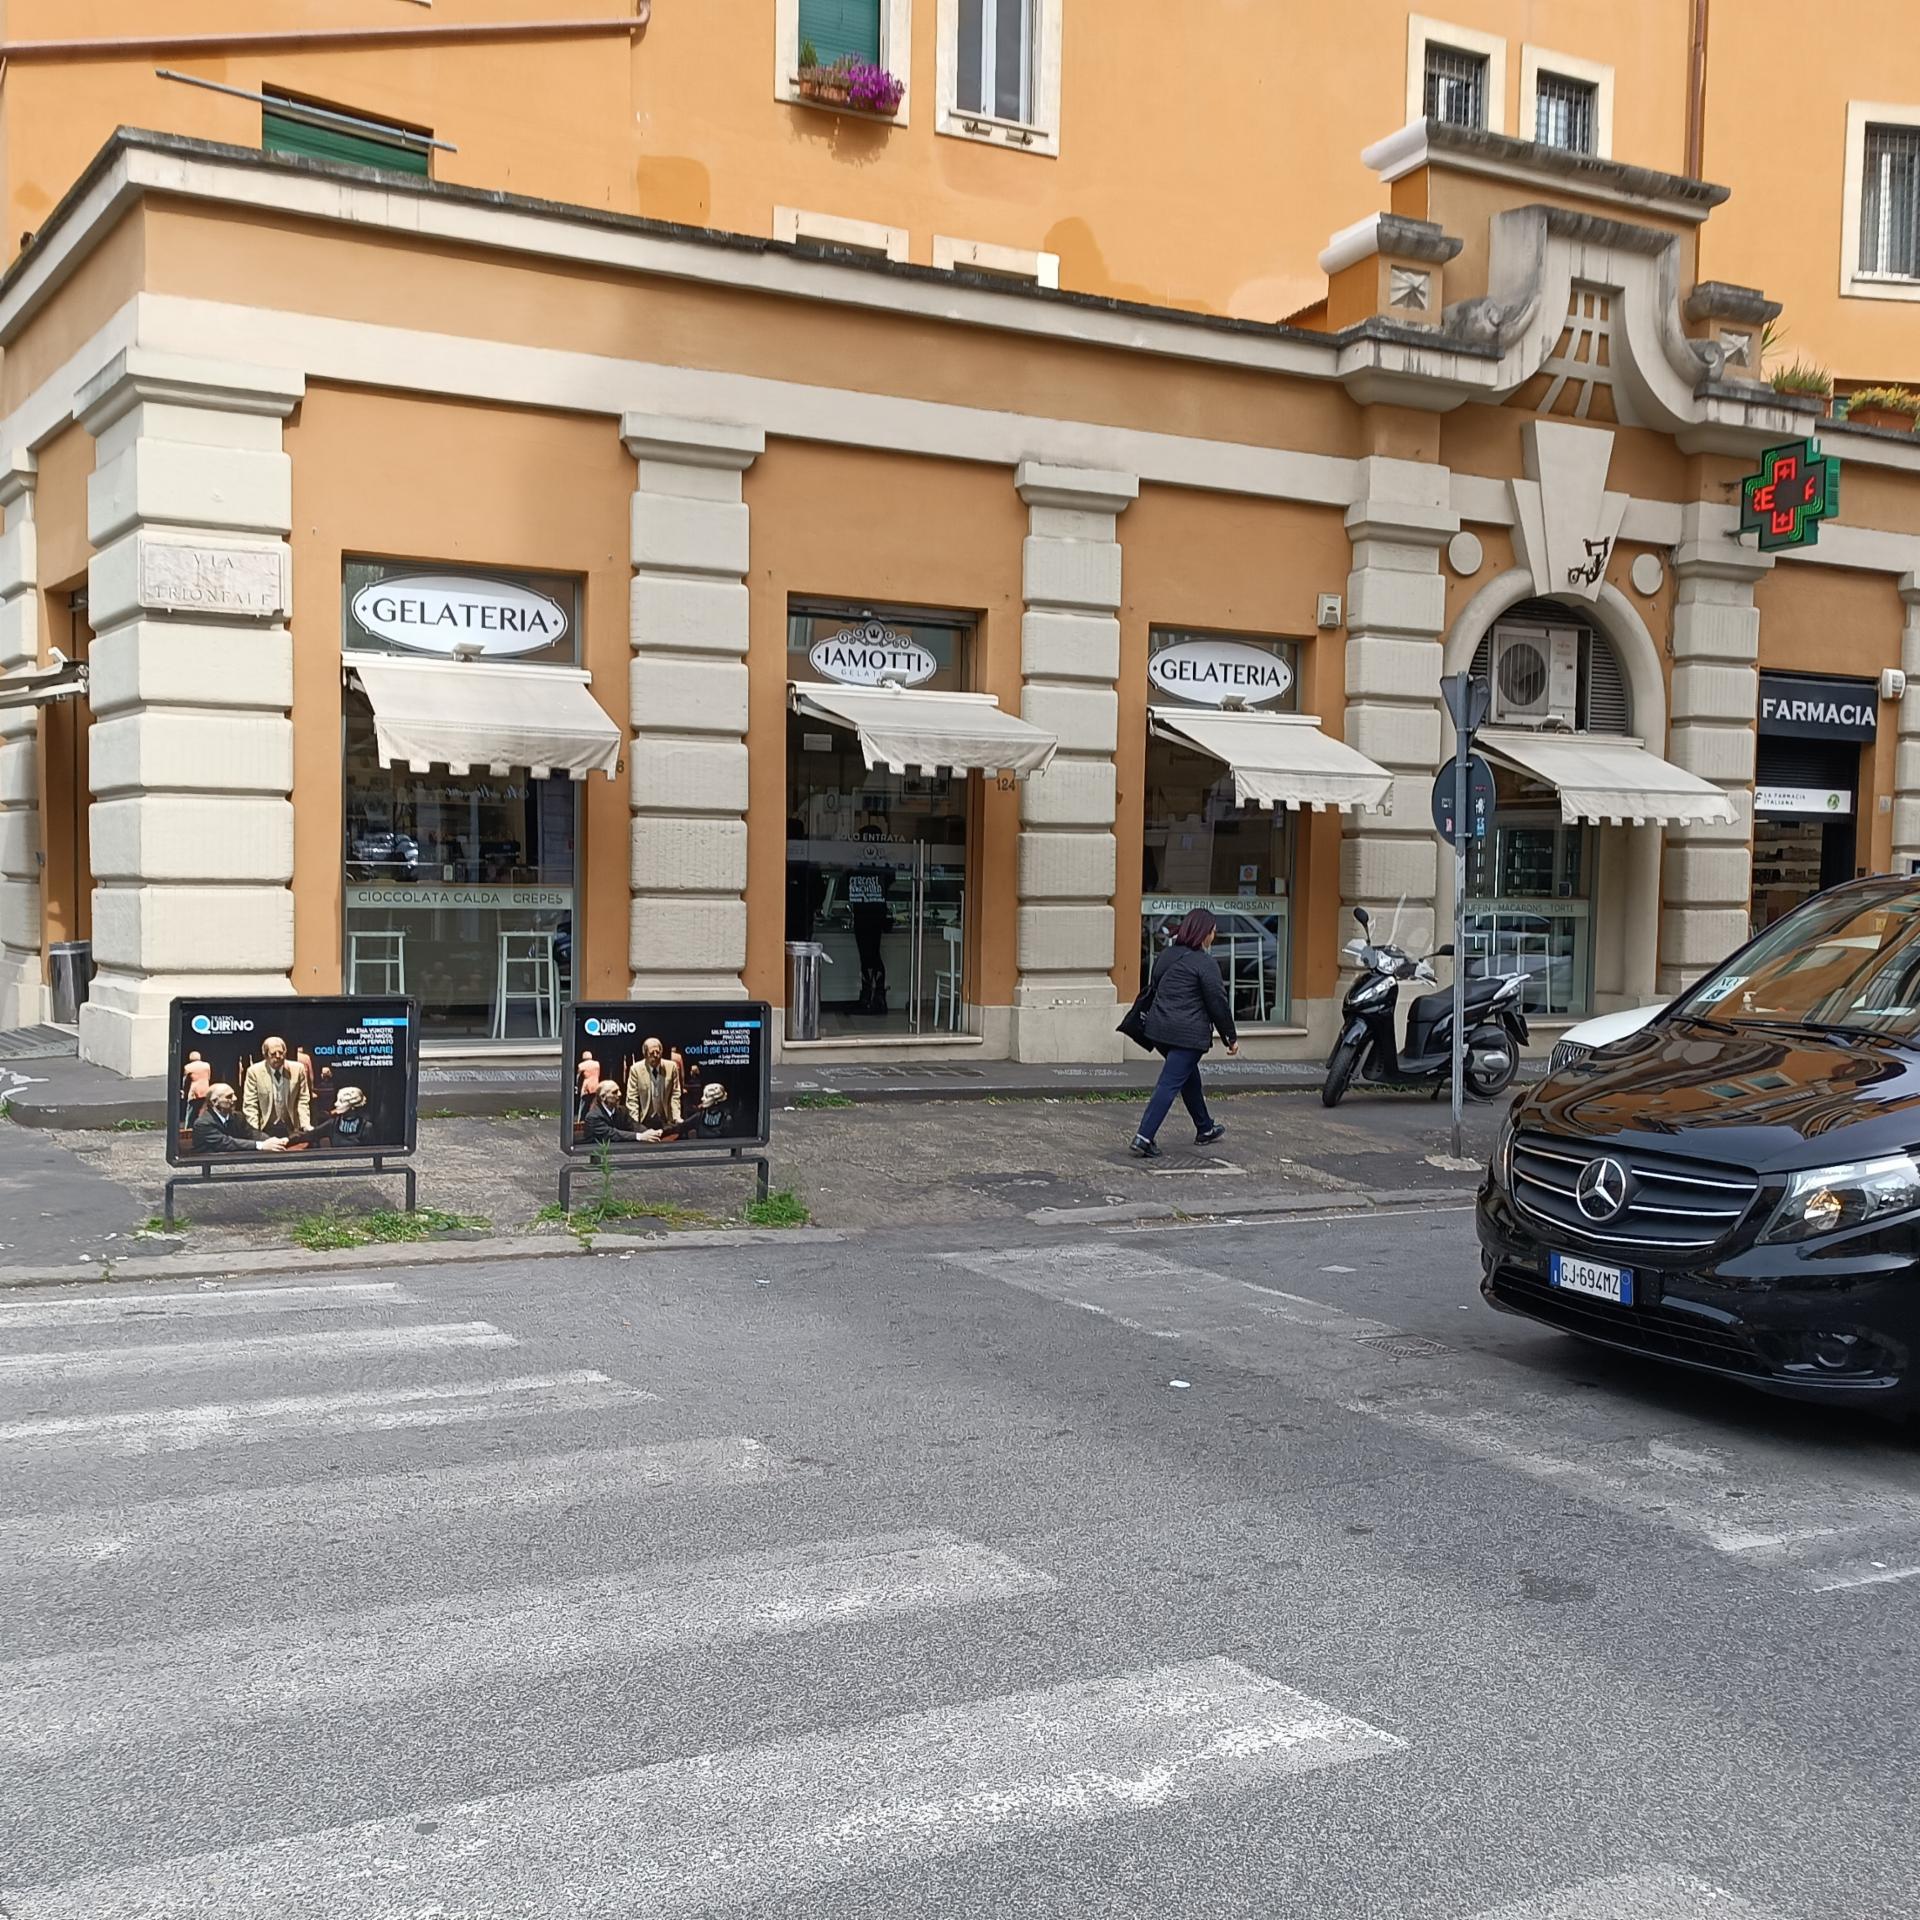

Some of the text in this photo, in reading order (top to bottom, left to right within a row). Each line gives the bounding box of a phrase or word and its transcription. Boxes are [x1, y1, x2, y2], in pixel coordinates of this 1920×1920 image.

[193, 553, 234, 568] VIA
[372, 597, 549, 633] GELATERIA
[824, 646, 921, 672] IAMOTTI
[1160, 658, 1281, 687] GELATERIA
[1762, 698, 1876, 726] FARMACIA
[997, 778, 1016, 791] 124
[1778, 793, 1806, 801] FARMACIA
[862, 832, 906, 843] ENTRATA
[358, 891, 563, 905] CIOCCOLATA CALDA CREPES
[1151, 900, 1276, 911] CAFFETTERIA CROISSANT
[1497, 903, 1543, 913] MACARONS
[1550, 904, 1575, 913] TORTE
[191, 1014, 254, 1034] QUIRINO
[584, 1017, 636, 1036] QUIRINO
